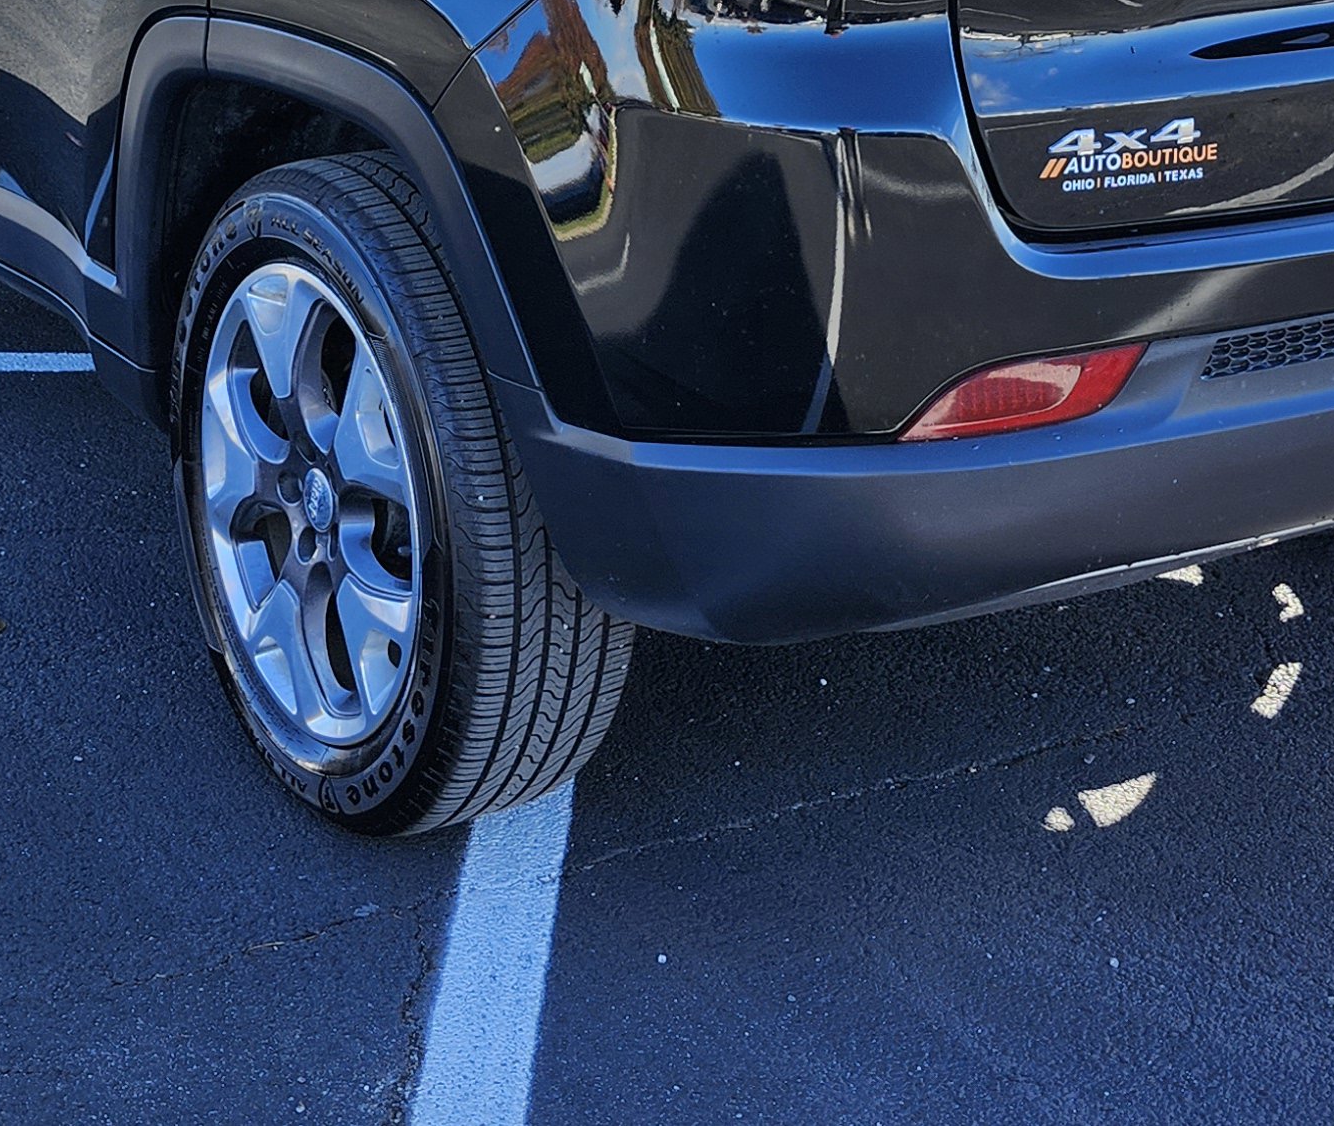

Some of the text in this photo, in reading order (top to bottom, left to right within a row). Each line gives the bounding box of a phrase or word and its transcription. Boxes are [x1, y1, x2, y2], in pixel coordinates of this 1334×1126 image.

[1048, 116, 1202, 156] 4x4
[1063, 143, 1218, 175] AUTOBOUTIQUE
[1062, 167, 1204, 192] OHIO FLORIDA TEXAS
